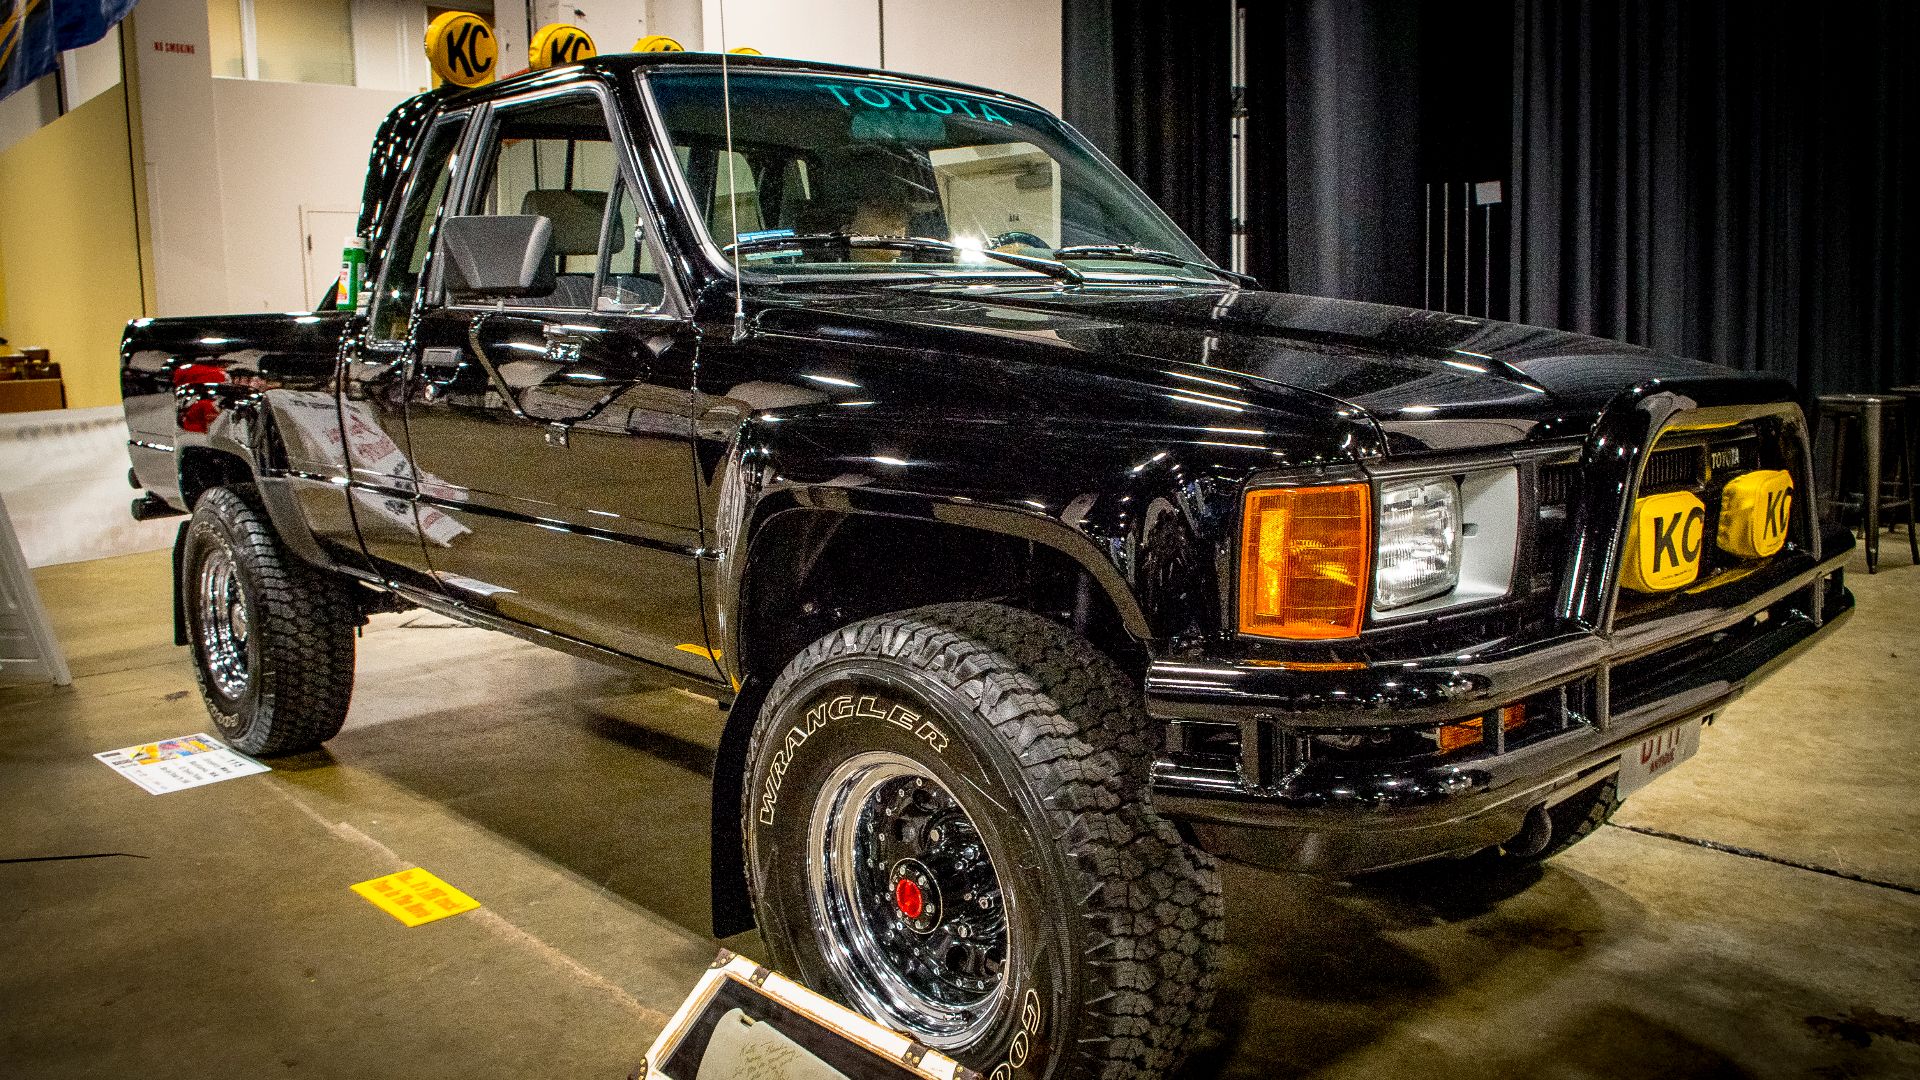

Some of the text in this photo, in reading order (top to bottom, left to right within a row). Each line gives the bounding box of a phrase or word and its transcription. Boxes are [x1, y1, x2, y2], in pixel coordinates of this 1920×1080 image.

[153, 41, 195, 54] NO SMOKING
[446, 22, 492, 77] KC
[550, 33, 590, 66] KC
[816, 84, 1013, 126] TOYOTA
[1652, 506, 1706, 574] KC
[1763, 486, 1794, 540] KC
[760, 695, 950, 825] WRANGLER
